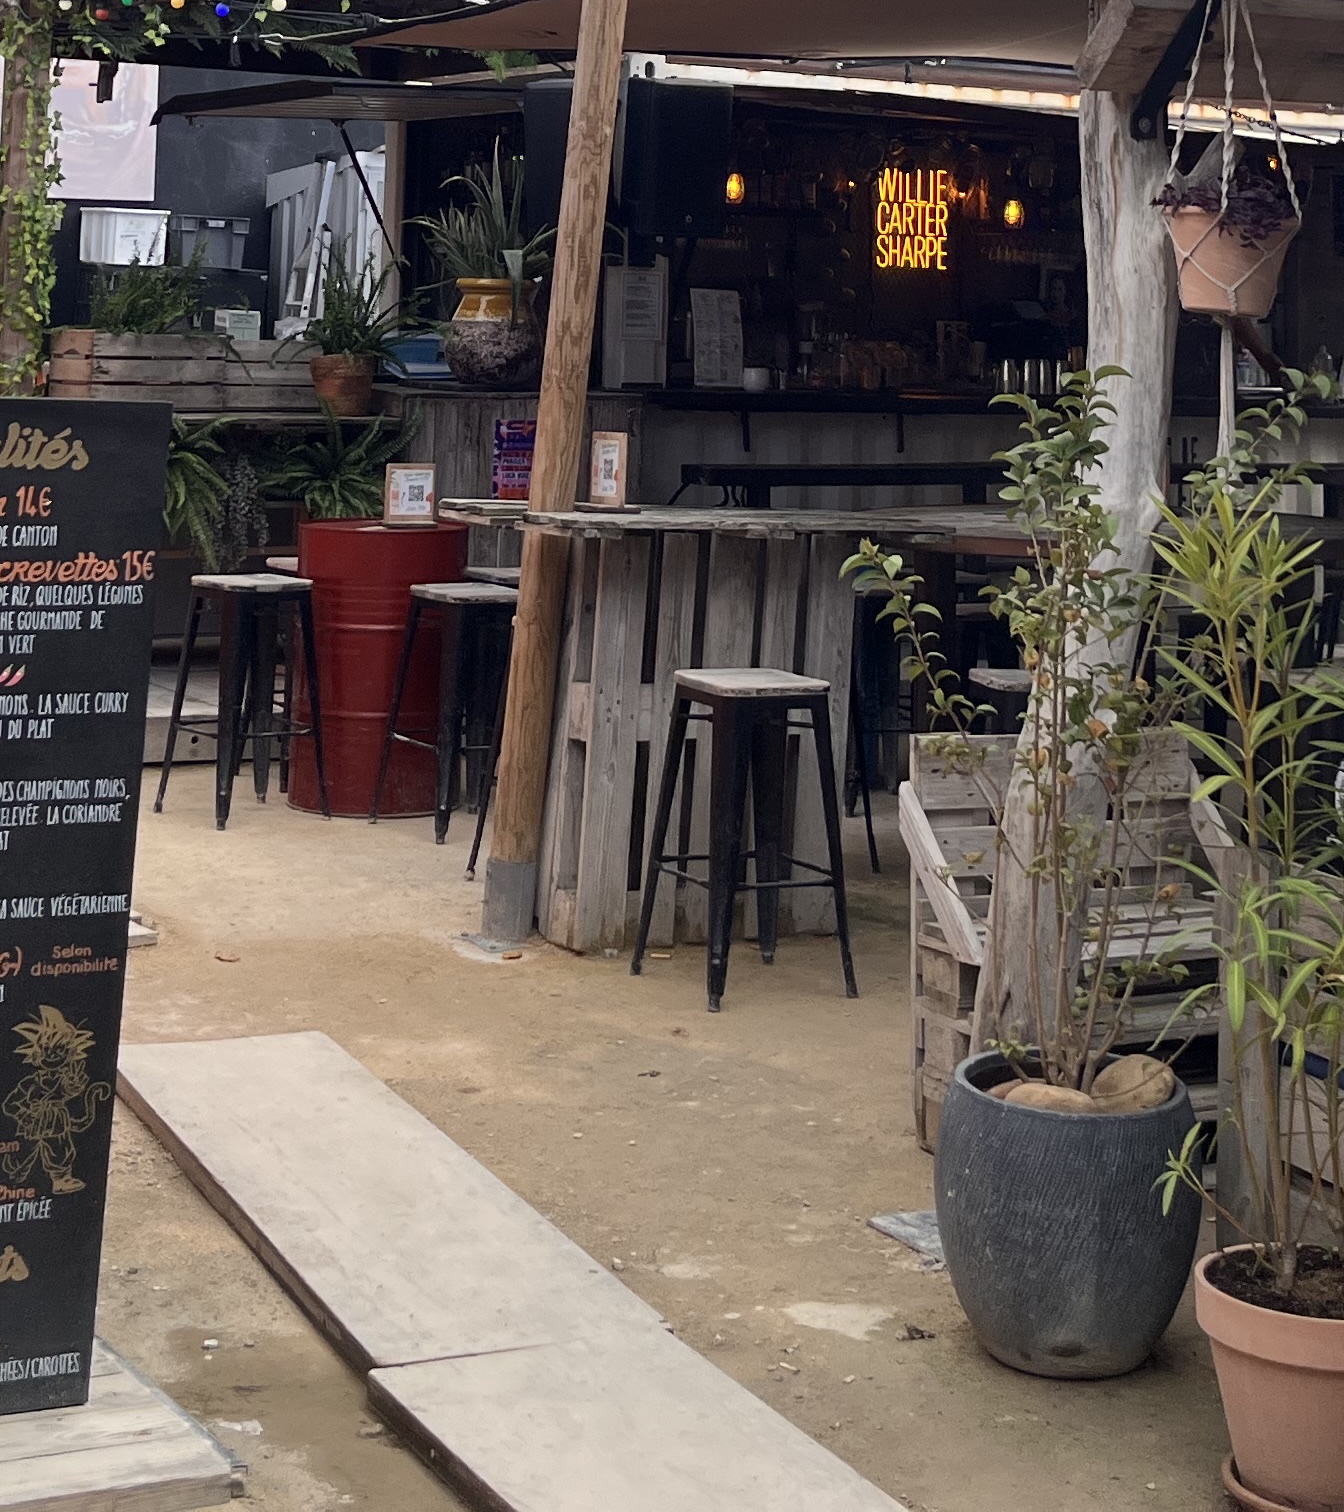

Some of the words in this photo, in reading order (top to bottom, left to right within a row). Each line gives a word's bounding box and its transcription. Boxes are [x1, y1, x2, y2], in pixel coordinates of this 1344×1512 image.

[878, 167, 947, 205] WILLIE
[877, 201, 949, 236] CARTER
[876, 234, 947, 270] SHARPE
[12, 524, 58, 547] CANTON
[122, 550, 155, 581] 15€
[35, 585, 93, 606] QUELQUES
[98, 582, 143, 605] LÉGUMES
[17, 610, 83, 630] GOURMANDE
[8, 634, 36, 655] VERT
[56, 692, 91, 715] SAUCE
[94, 692, 129, 714] CURRY
[27, 718, 55, 739] PLAT
[16, 777, 89, 802] CHAMPIGNONS
[62, 802, 123, 824] CORIANDRE
[10, 896, 44, 919] SAUCE
[51, 943, 92, 959] Selon
